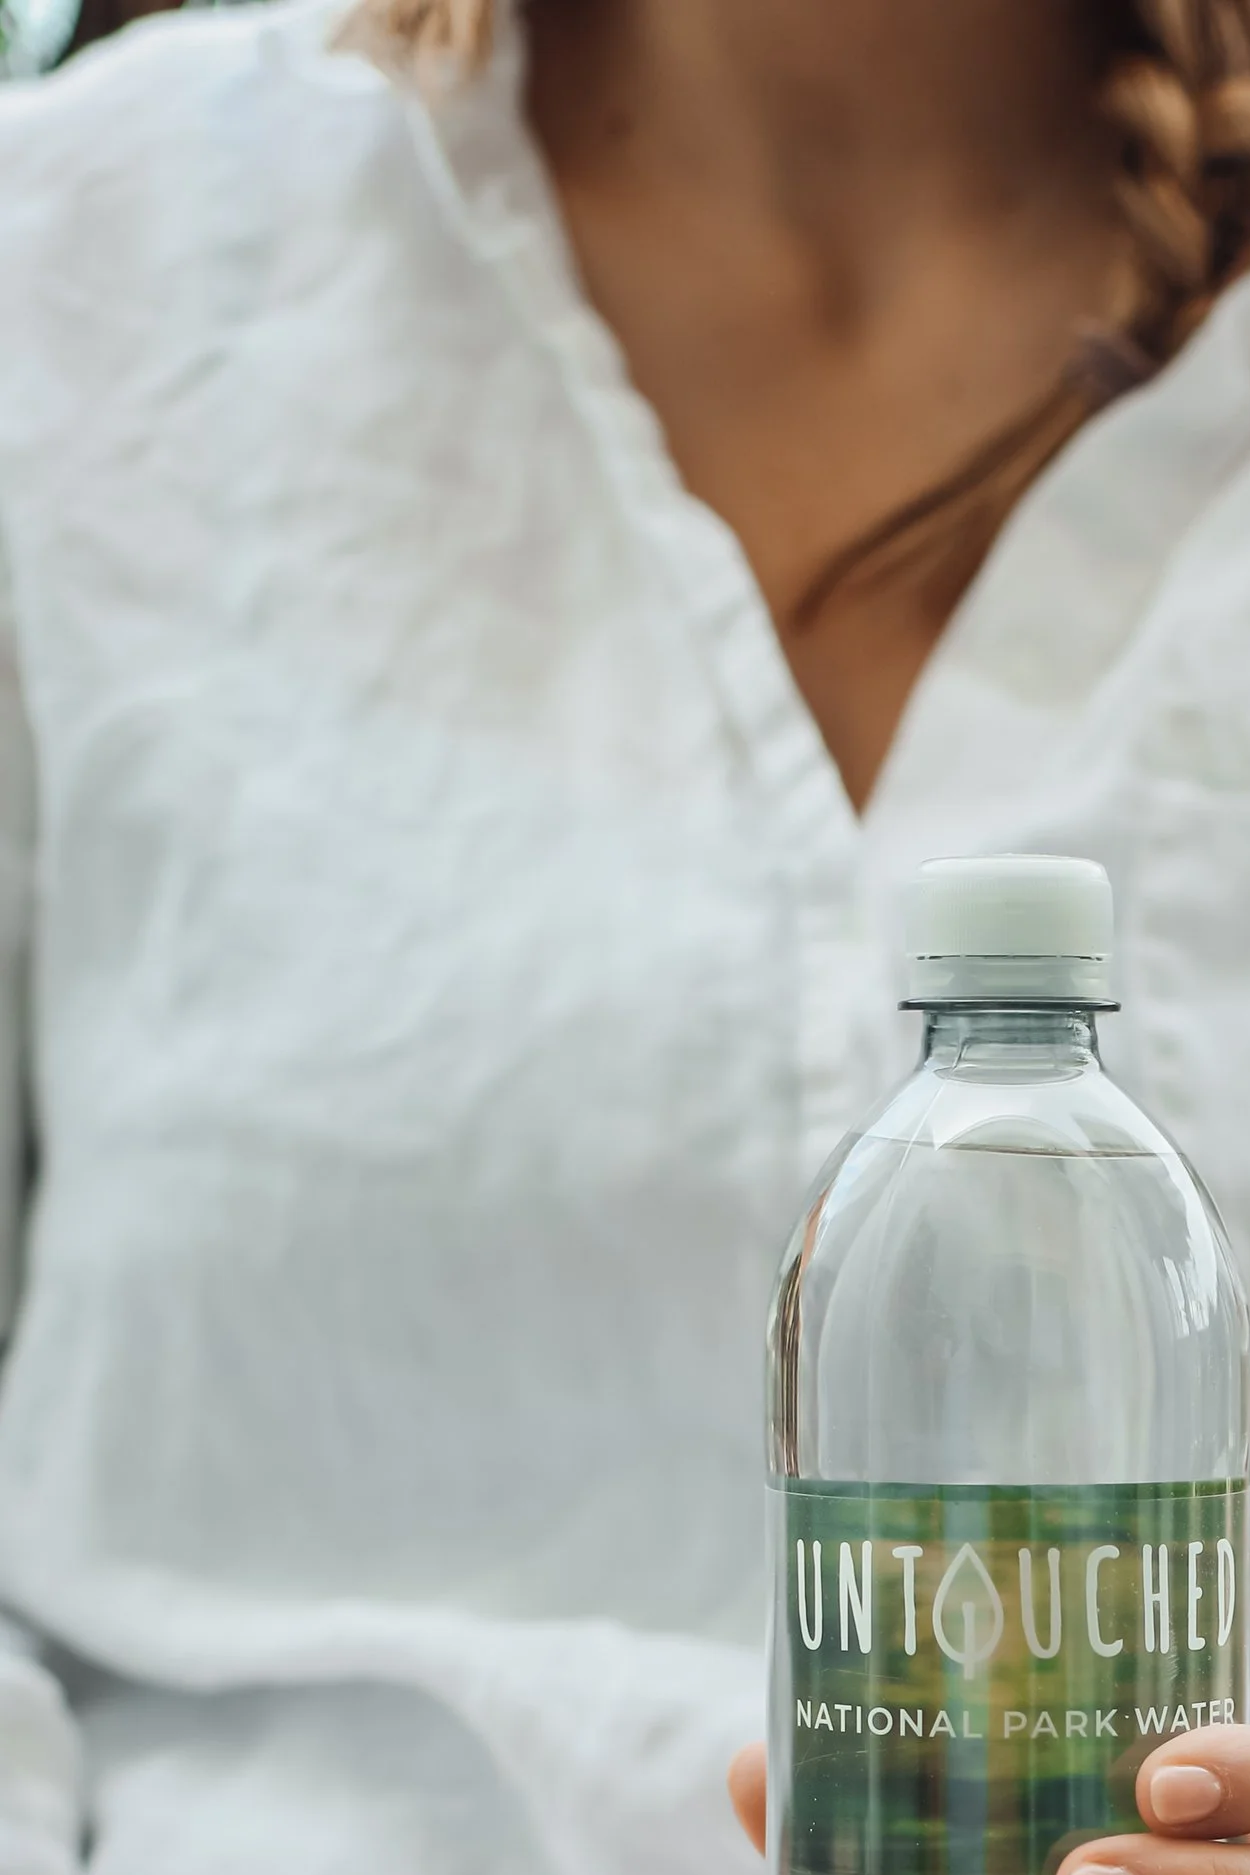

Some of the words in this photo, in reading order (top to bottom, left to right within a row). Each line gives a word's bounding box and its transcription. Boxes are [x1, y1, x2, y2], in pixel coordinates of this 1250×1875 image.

[796, 1538, 1236, 1680] UNTOUCHED
[796, 1699, 983, 1739] NATIONAL
[1003, 1709, 1119, 1739] PARK
[1134, 1698, 1236, 1735] WATER
